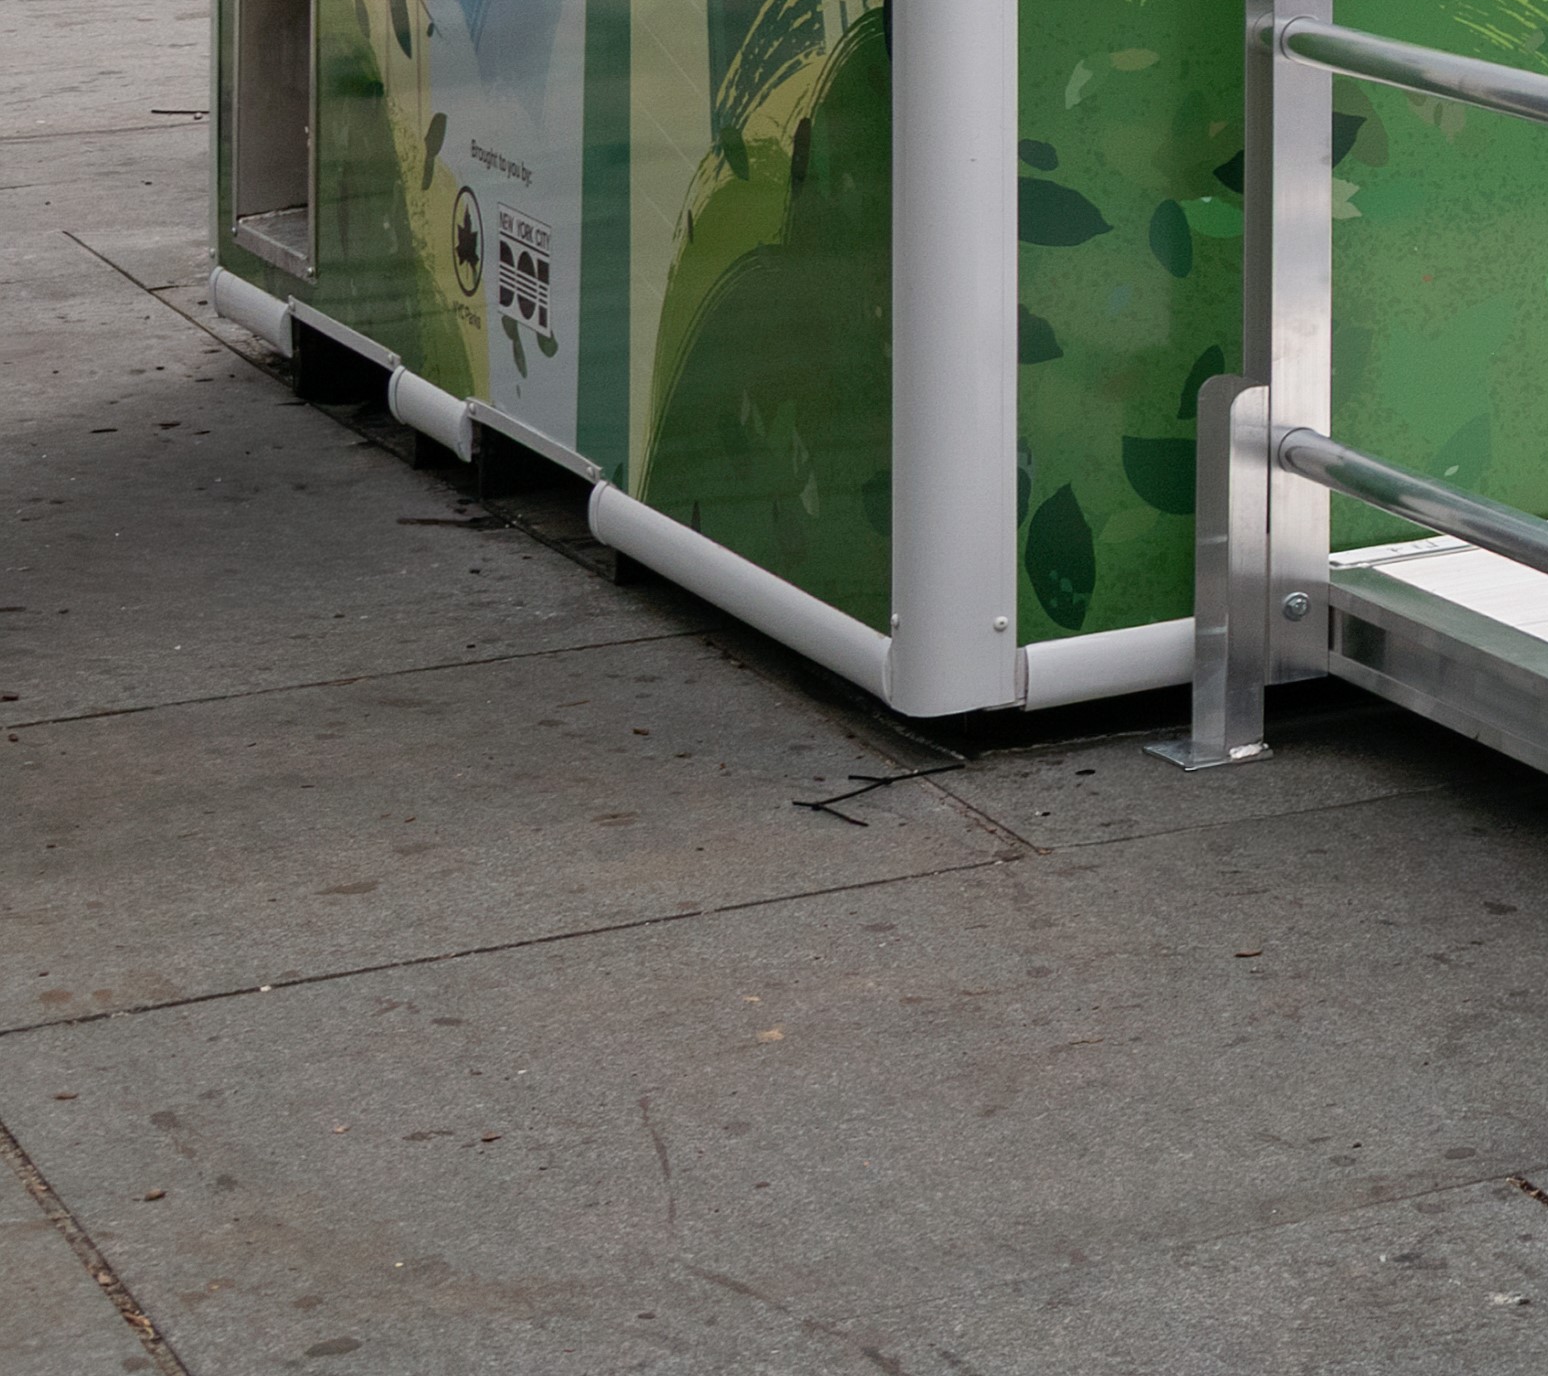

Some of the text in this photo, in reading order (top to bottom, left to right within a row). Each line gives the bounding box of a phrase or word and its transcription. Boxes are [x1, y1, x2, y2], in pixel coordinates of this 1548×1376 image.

[498, 152, 507, 172] to
[499, 210, 551, 251] NEW YORK CITY
[499, 239, 550, 329] DOT
